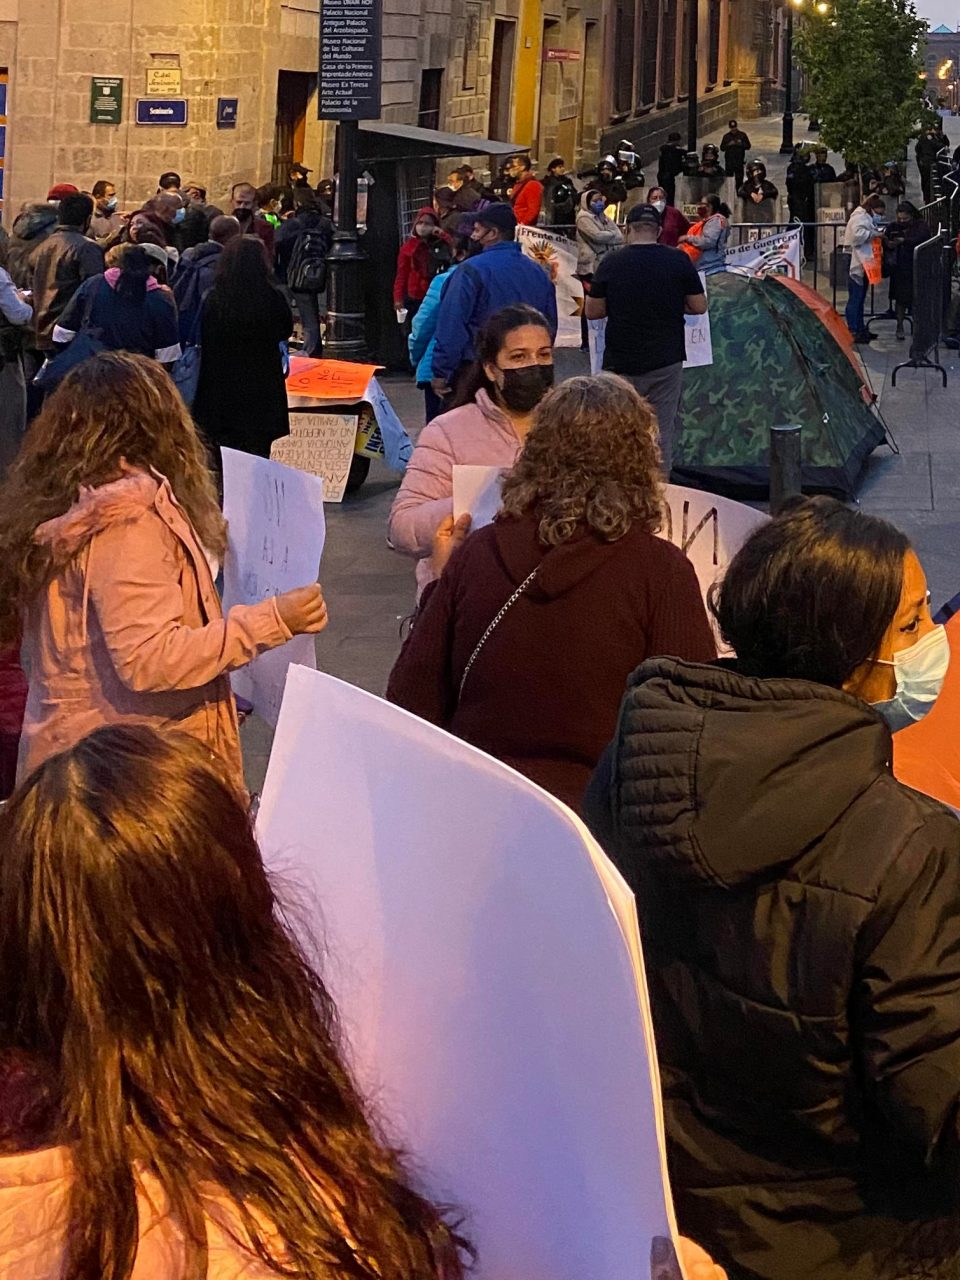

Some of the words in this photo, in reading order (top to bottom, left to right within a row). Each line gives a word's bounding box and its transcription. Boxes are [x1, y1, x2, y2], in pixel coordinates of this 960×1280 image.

[520, 227, 554, 241] Frente
[555, 236, 568, 245] de
[738, 244, 751, 254] de
[753, 234, 798, 250] Guerrero
[690, 328, 706, 344] EN
[307, 416, 338, 426] FAMILIA
[344, 416, 355, 425] LA
[328, 428, 338, 437] AL
[340, 428, 355, 437] NO
